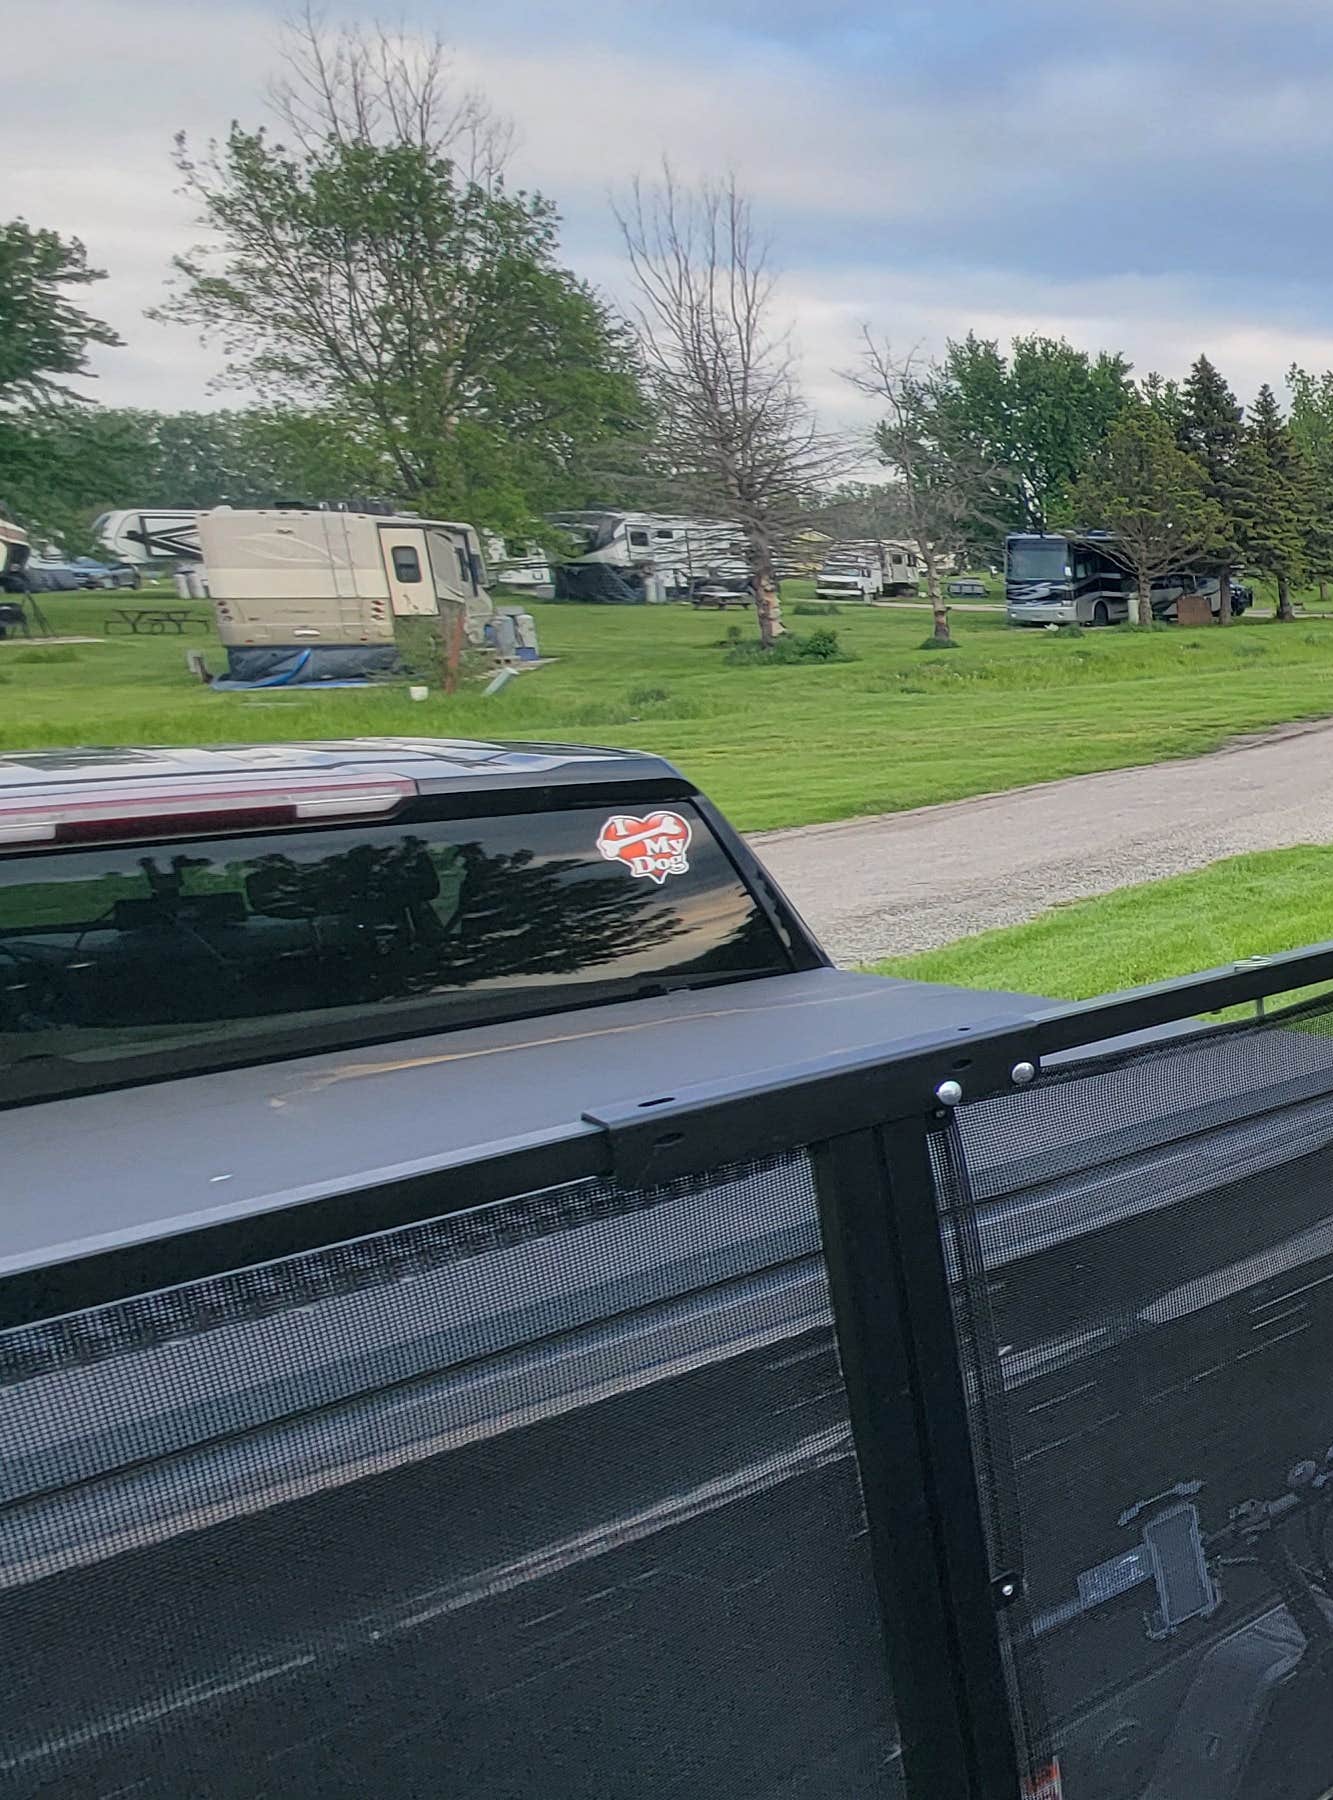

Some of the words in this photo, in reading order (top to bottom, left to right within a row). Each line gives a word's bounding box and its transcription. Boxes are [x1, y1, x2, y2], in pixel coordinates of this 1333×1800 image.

[613, 818, 630, 836] I
[643, 837, 685, 856] My
[632, 855, 686, 874] Dog
